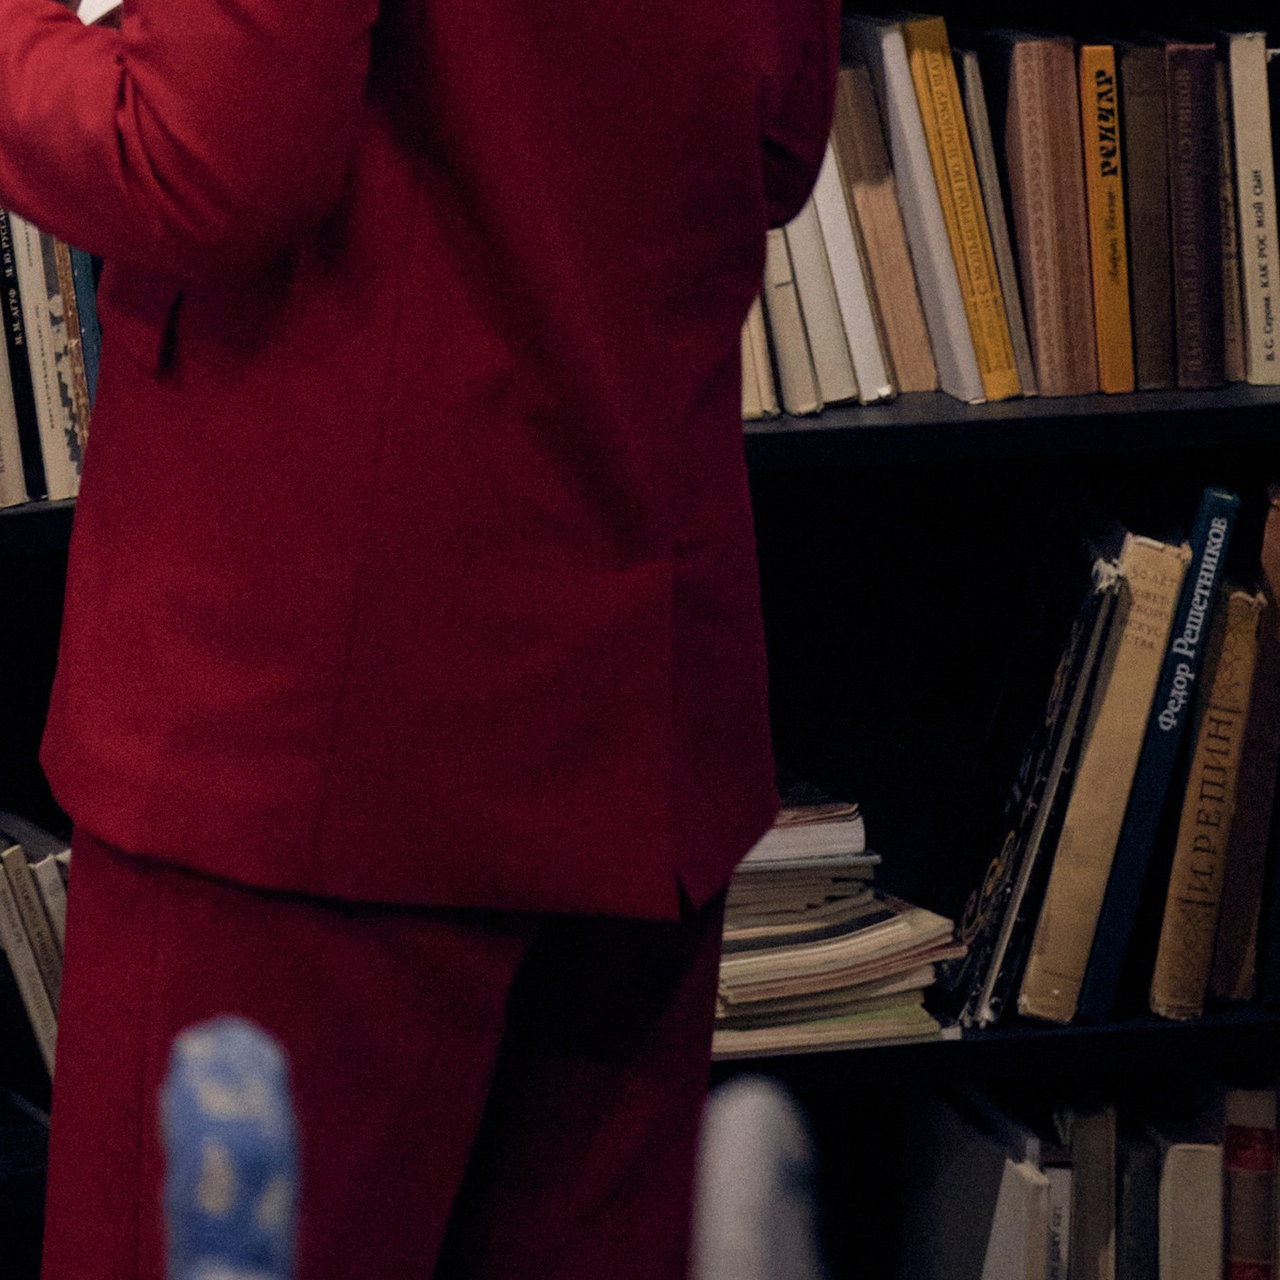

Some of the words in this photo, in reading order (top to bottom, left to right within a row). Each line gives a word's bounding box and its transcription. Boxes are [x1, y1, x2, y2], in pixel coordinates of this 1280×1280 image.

[1252, 170, 1263, 196] СЫН
[1253, 201, 1264, 228] МОЙ
[1260, 264, 1269, 288] КАК
[1171, 518, 1228, 658] Решетников
[1157, 662, 1194, 731] Федор
